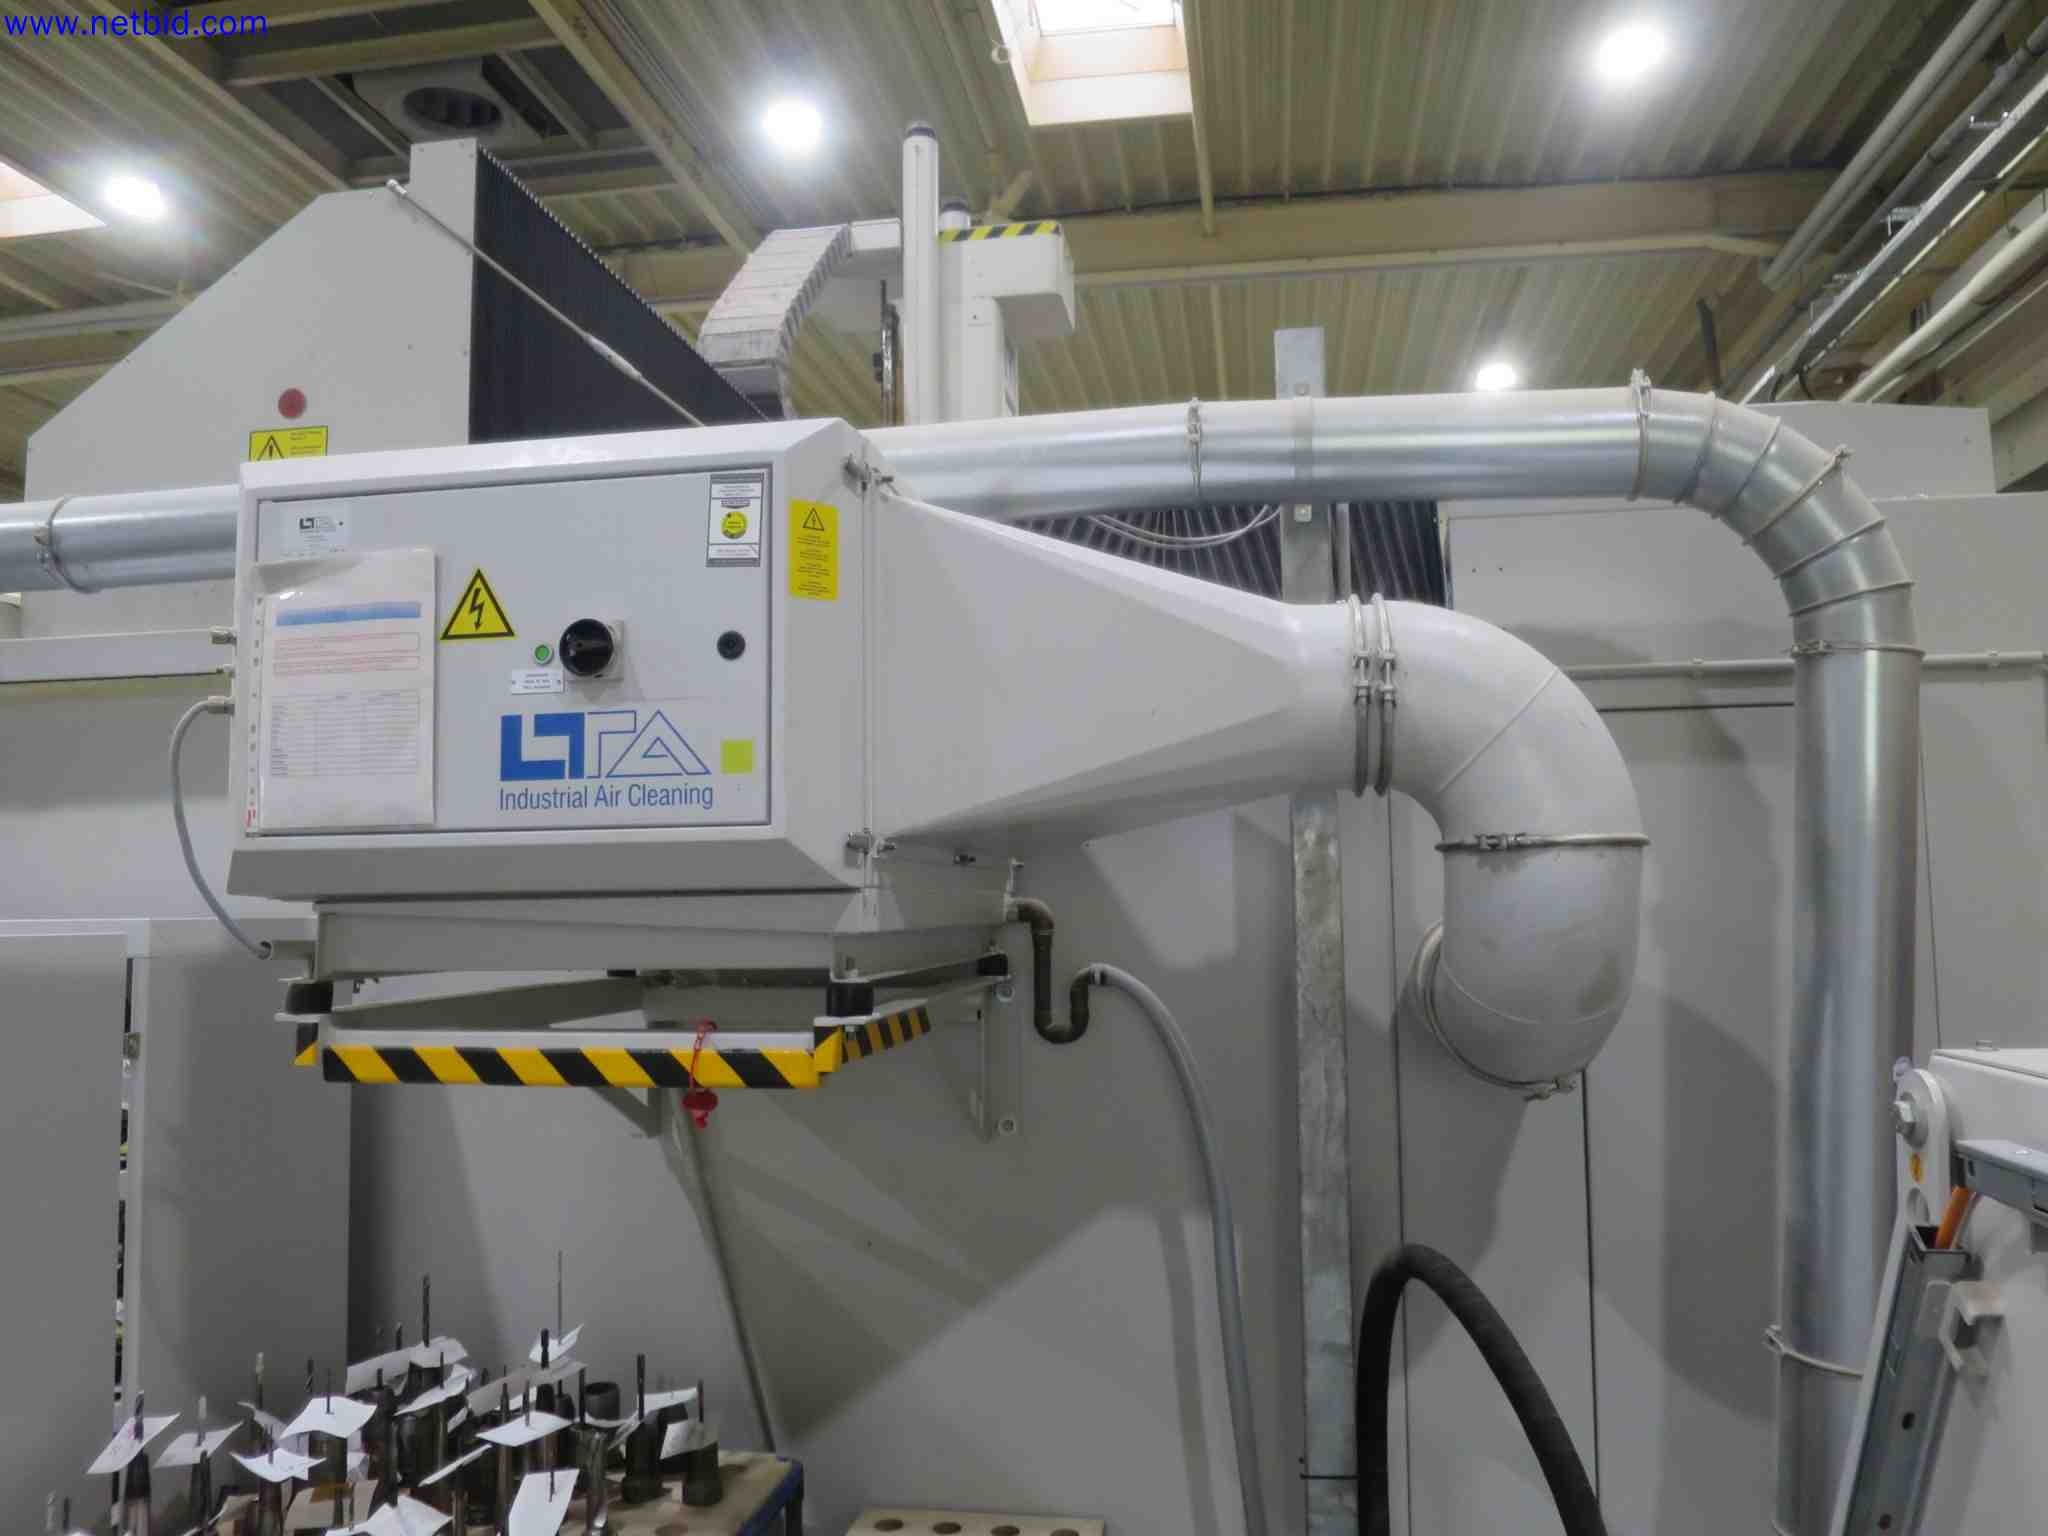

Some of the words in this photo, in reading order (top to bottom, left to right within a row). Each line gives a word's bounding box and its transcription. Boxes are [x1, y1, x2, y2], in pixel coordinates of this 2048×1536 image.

[500, 786, 588, 810] Industrial
[594, 784, 624, 807] Air
[628, 783, 713, 809] Cleaning
